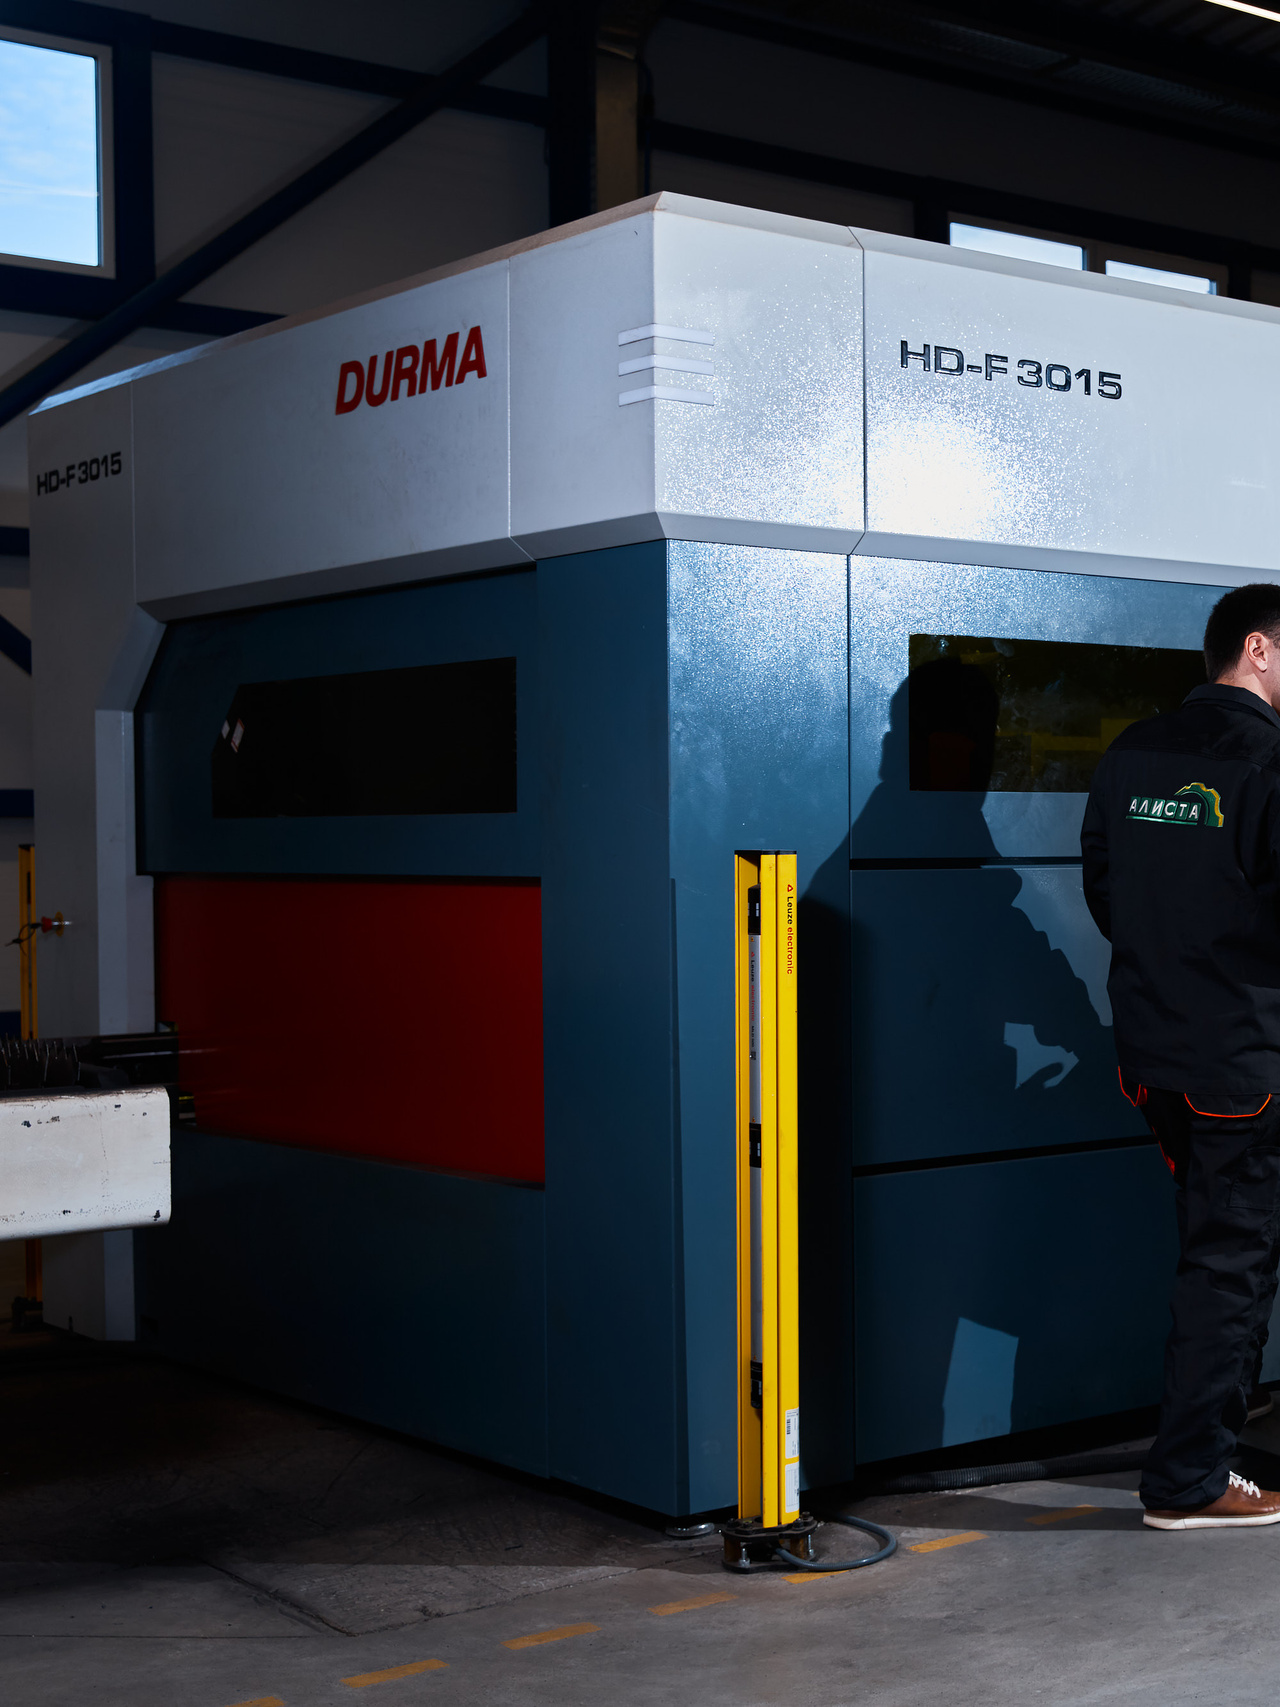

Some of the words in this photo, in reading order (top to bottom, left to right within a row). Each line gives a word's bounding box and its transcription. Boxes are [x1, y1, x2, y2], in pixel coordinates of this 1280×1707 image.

[335, 326, 487, 415] DURMA
[1017, 359, 1122, 400] 3015
[1129, 798, 1198, 819] АЛИСТА
